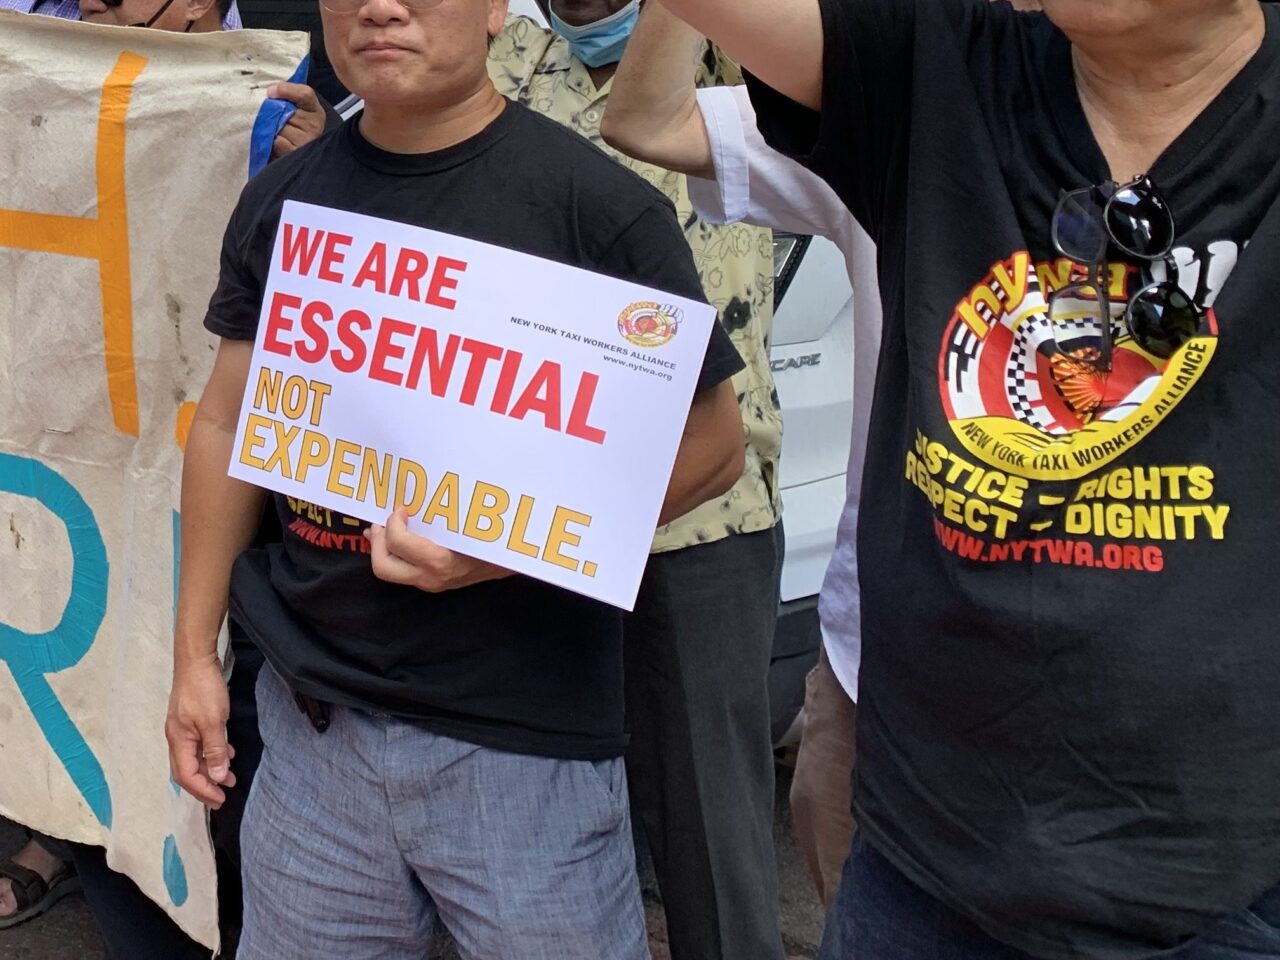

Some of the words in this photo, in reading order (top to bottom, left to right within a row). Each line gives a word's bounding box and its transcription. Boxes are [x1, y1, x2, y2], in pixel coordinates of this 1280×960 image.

[280, 222, 353, 284] WE
[352, 242, 468, 310] ARE
[262, 292, 608, 446] ESSENTIAL
[510, 316, 531, 327] NEW
[534, 323, 557, 335] YORK
[560, 330, 581, 342] TAXI
[584, 336, 628, 356] WORKERS
[630, 352, 676, 370] ALLIANCE
[603, 354, 672, 382] www.nytwa.org
[254, 368, 332, 426] NOT
[960, 422, 992, 451] NEW
[992, 440, 1026, 468] YORK
[1032, 454, 1069, 470] TAXI
[1073, 415, 1154, 467] WORKERS
[1154, 341, 1206, 416] ALLIANCE
[239, 413, 598, 578] EXPENDABLE.
[1074, 465, 1214, 502] RIGHTS
[1065, 504, 1230, 540] DIGNITY
